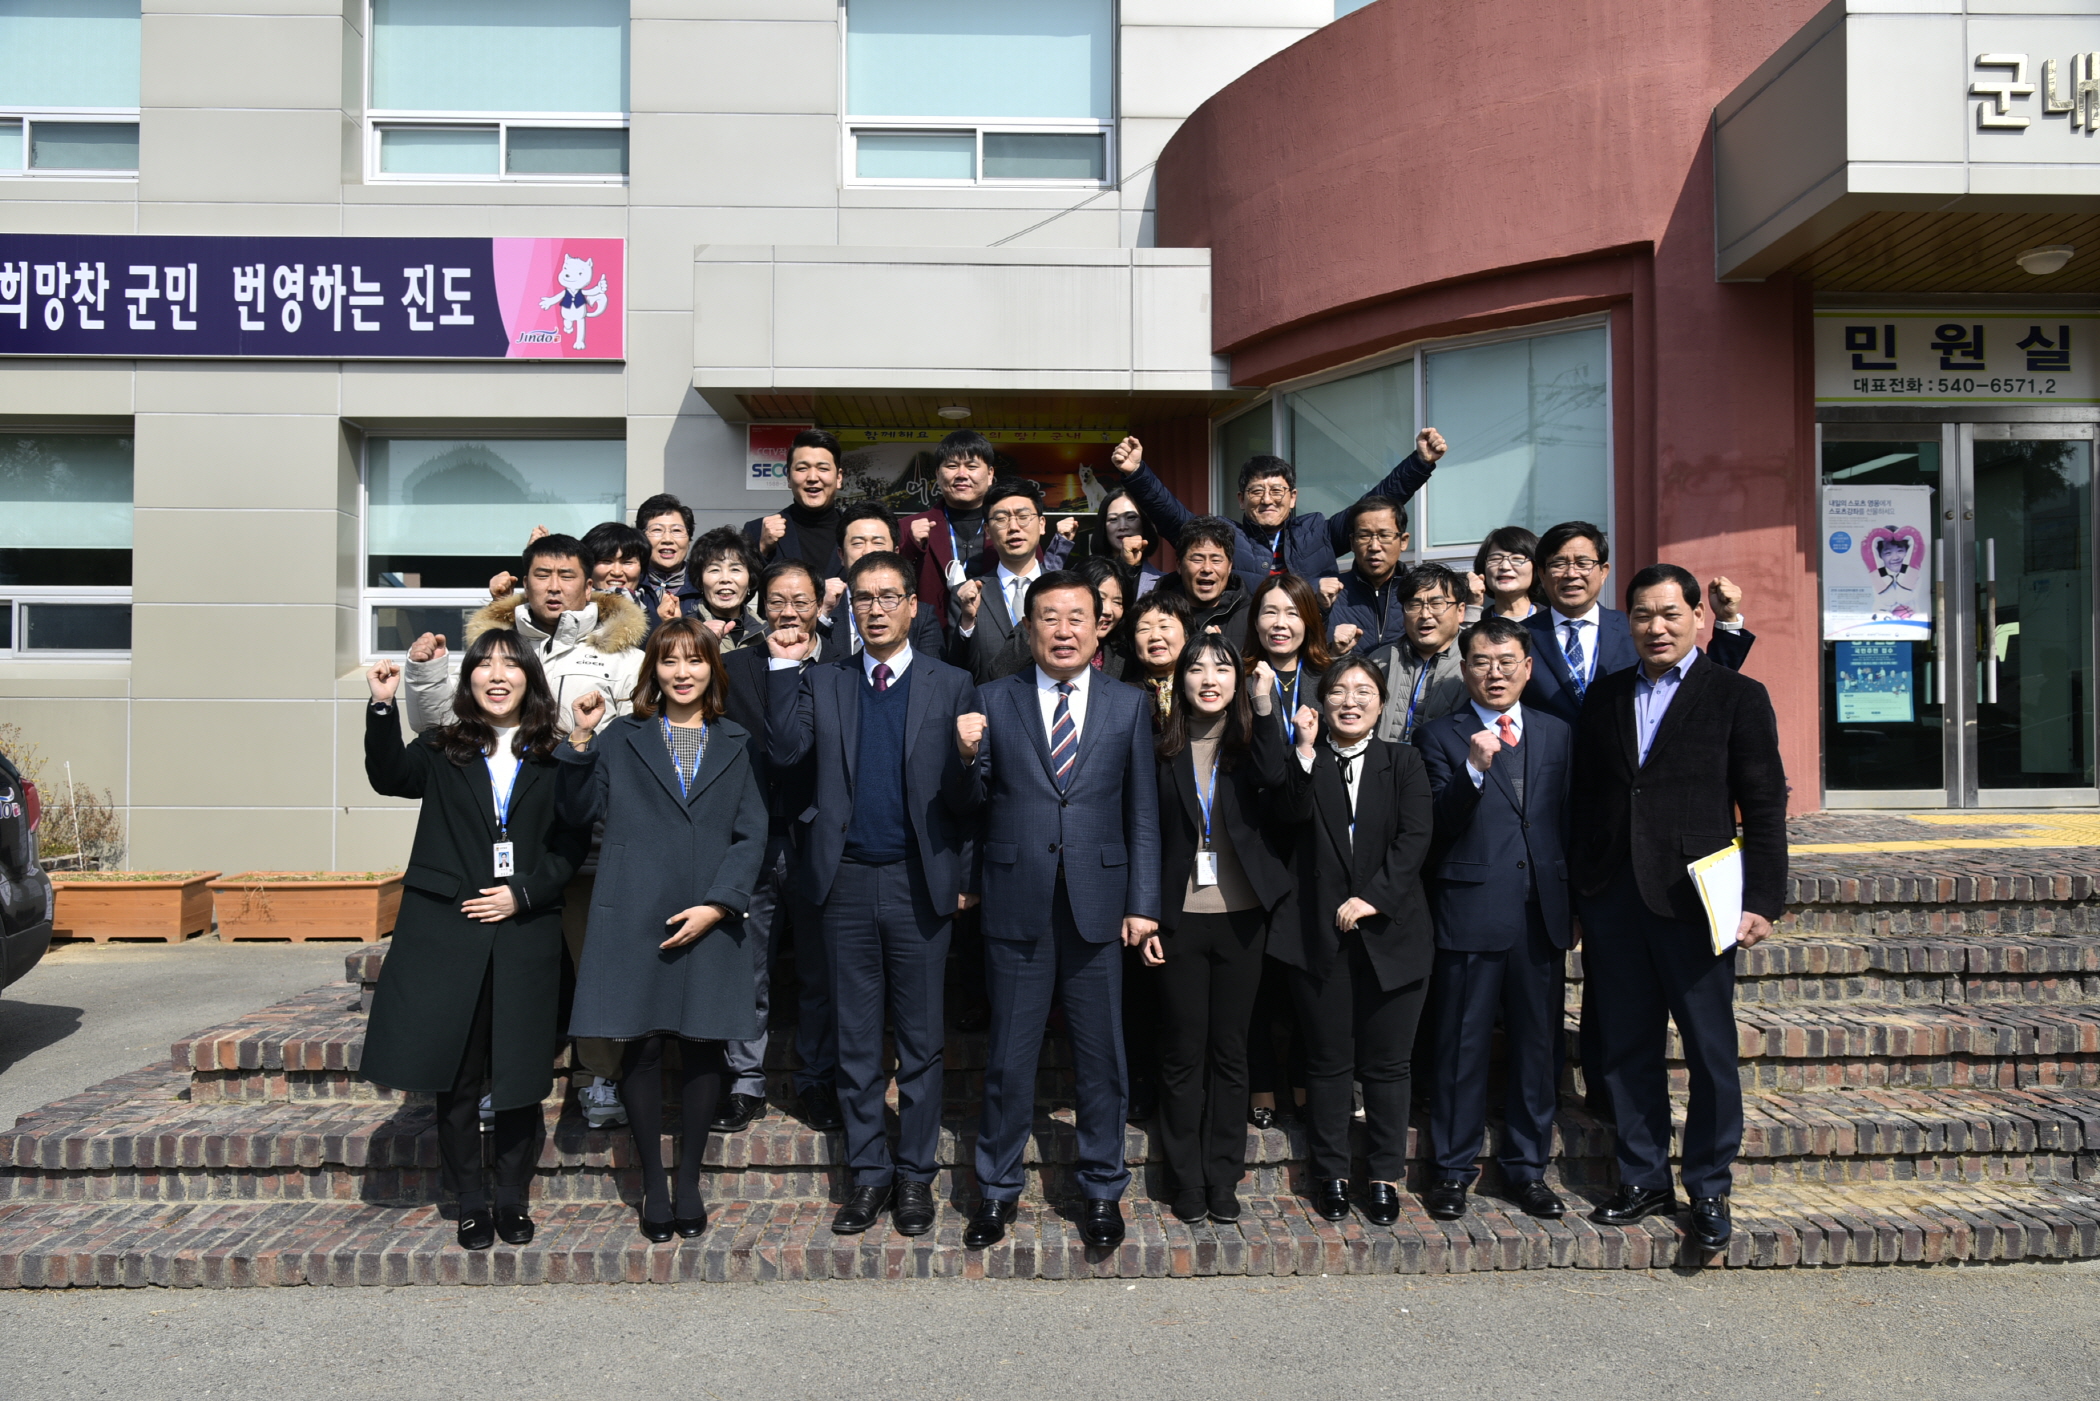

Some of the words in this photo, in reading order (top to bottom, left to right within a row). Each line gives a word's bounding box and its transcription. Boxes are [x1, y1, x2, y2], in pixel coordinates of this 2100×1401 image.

[1969, 52, 2100, 131] 군내
[0, 261, 109, 330] 희망찬
[125, 263, 198, 330] 군민
[233, 263, 384, 333] 번영하는
[402, 264, 475, 332] 진도
[516, 331, 553, 343] Jindo
[1845, 323, 2071, 372] 민원실
[864, 430, 928, 440] 함께해요
[1050, 431, 1082, 441] 군내
[757, 447, 789, 457] CCTV작
